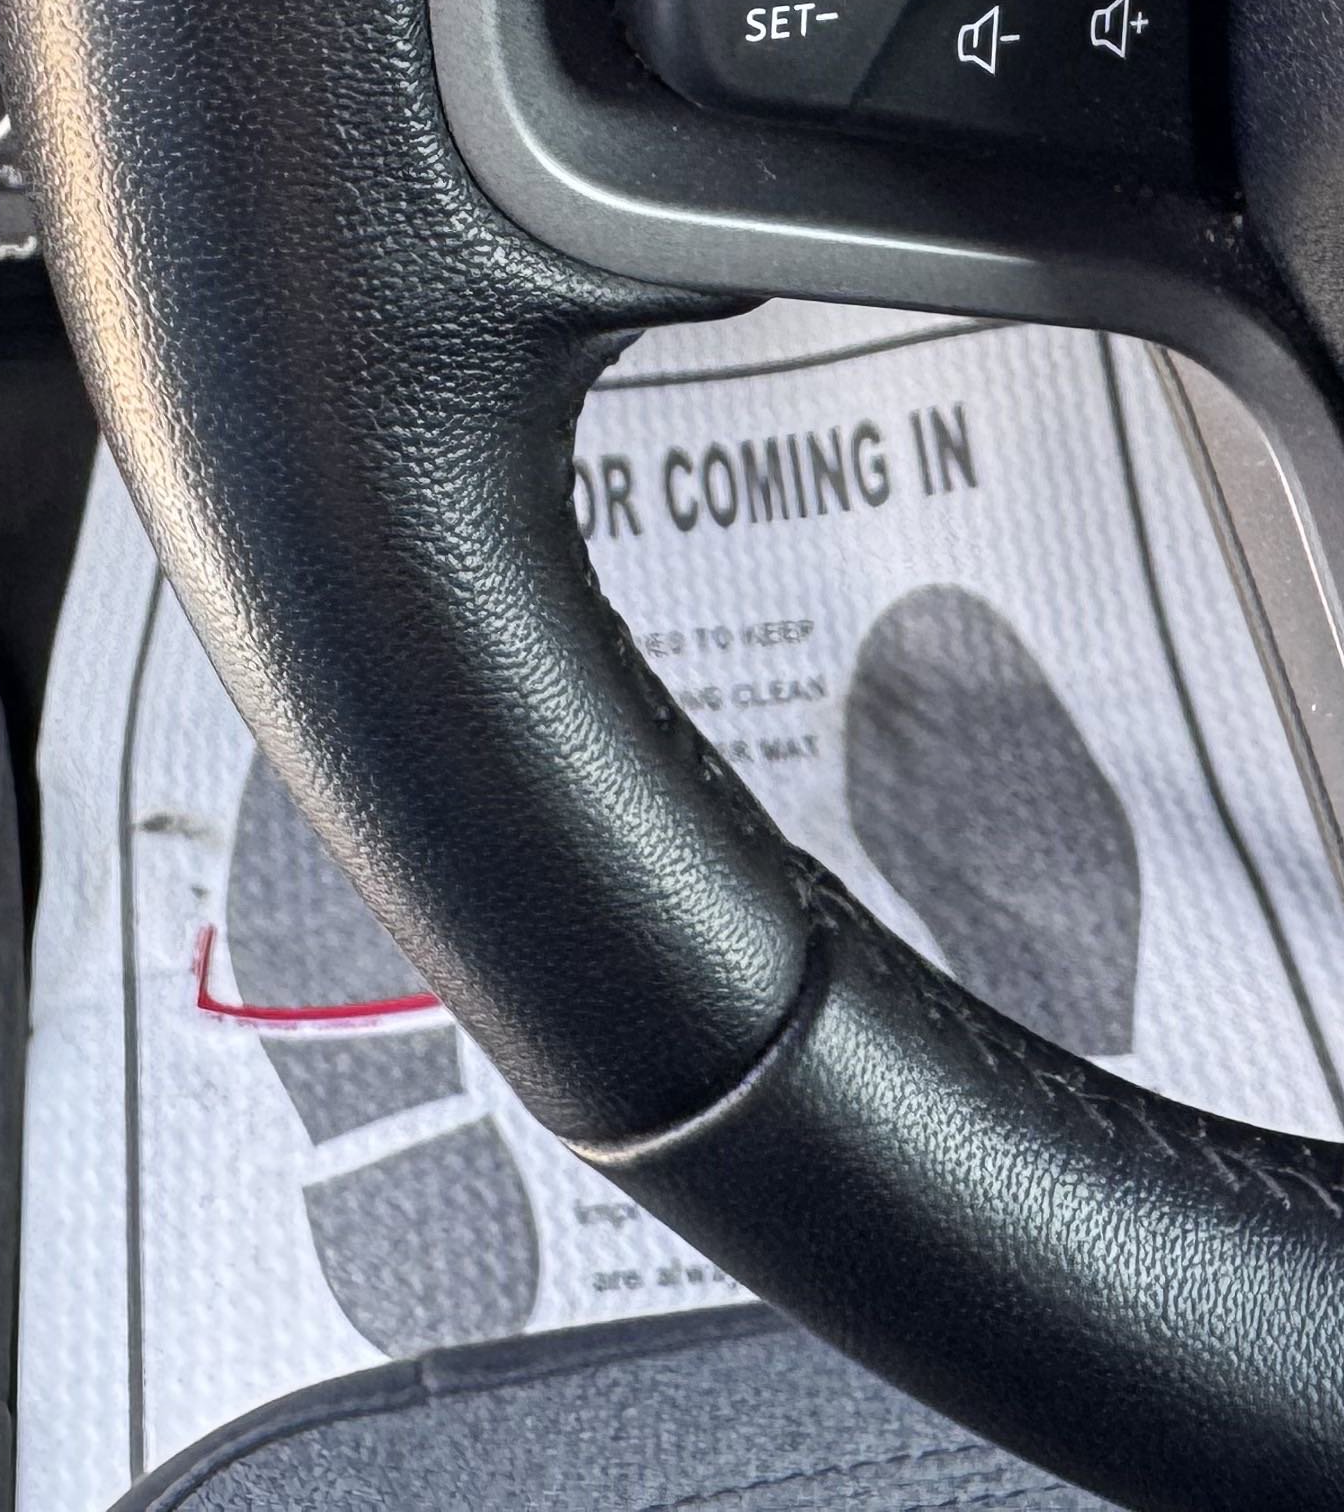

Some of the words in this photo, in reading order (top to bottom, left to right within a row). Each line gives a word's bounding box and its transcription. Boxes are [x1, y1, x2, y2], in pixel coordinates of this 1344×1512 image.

[745, 4, 839, 42] SET-
[665, 419, 890, 532] COMING
[911, 403, 977, 495] IN
